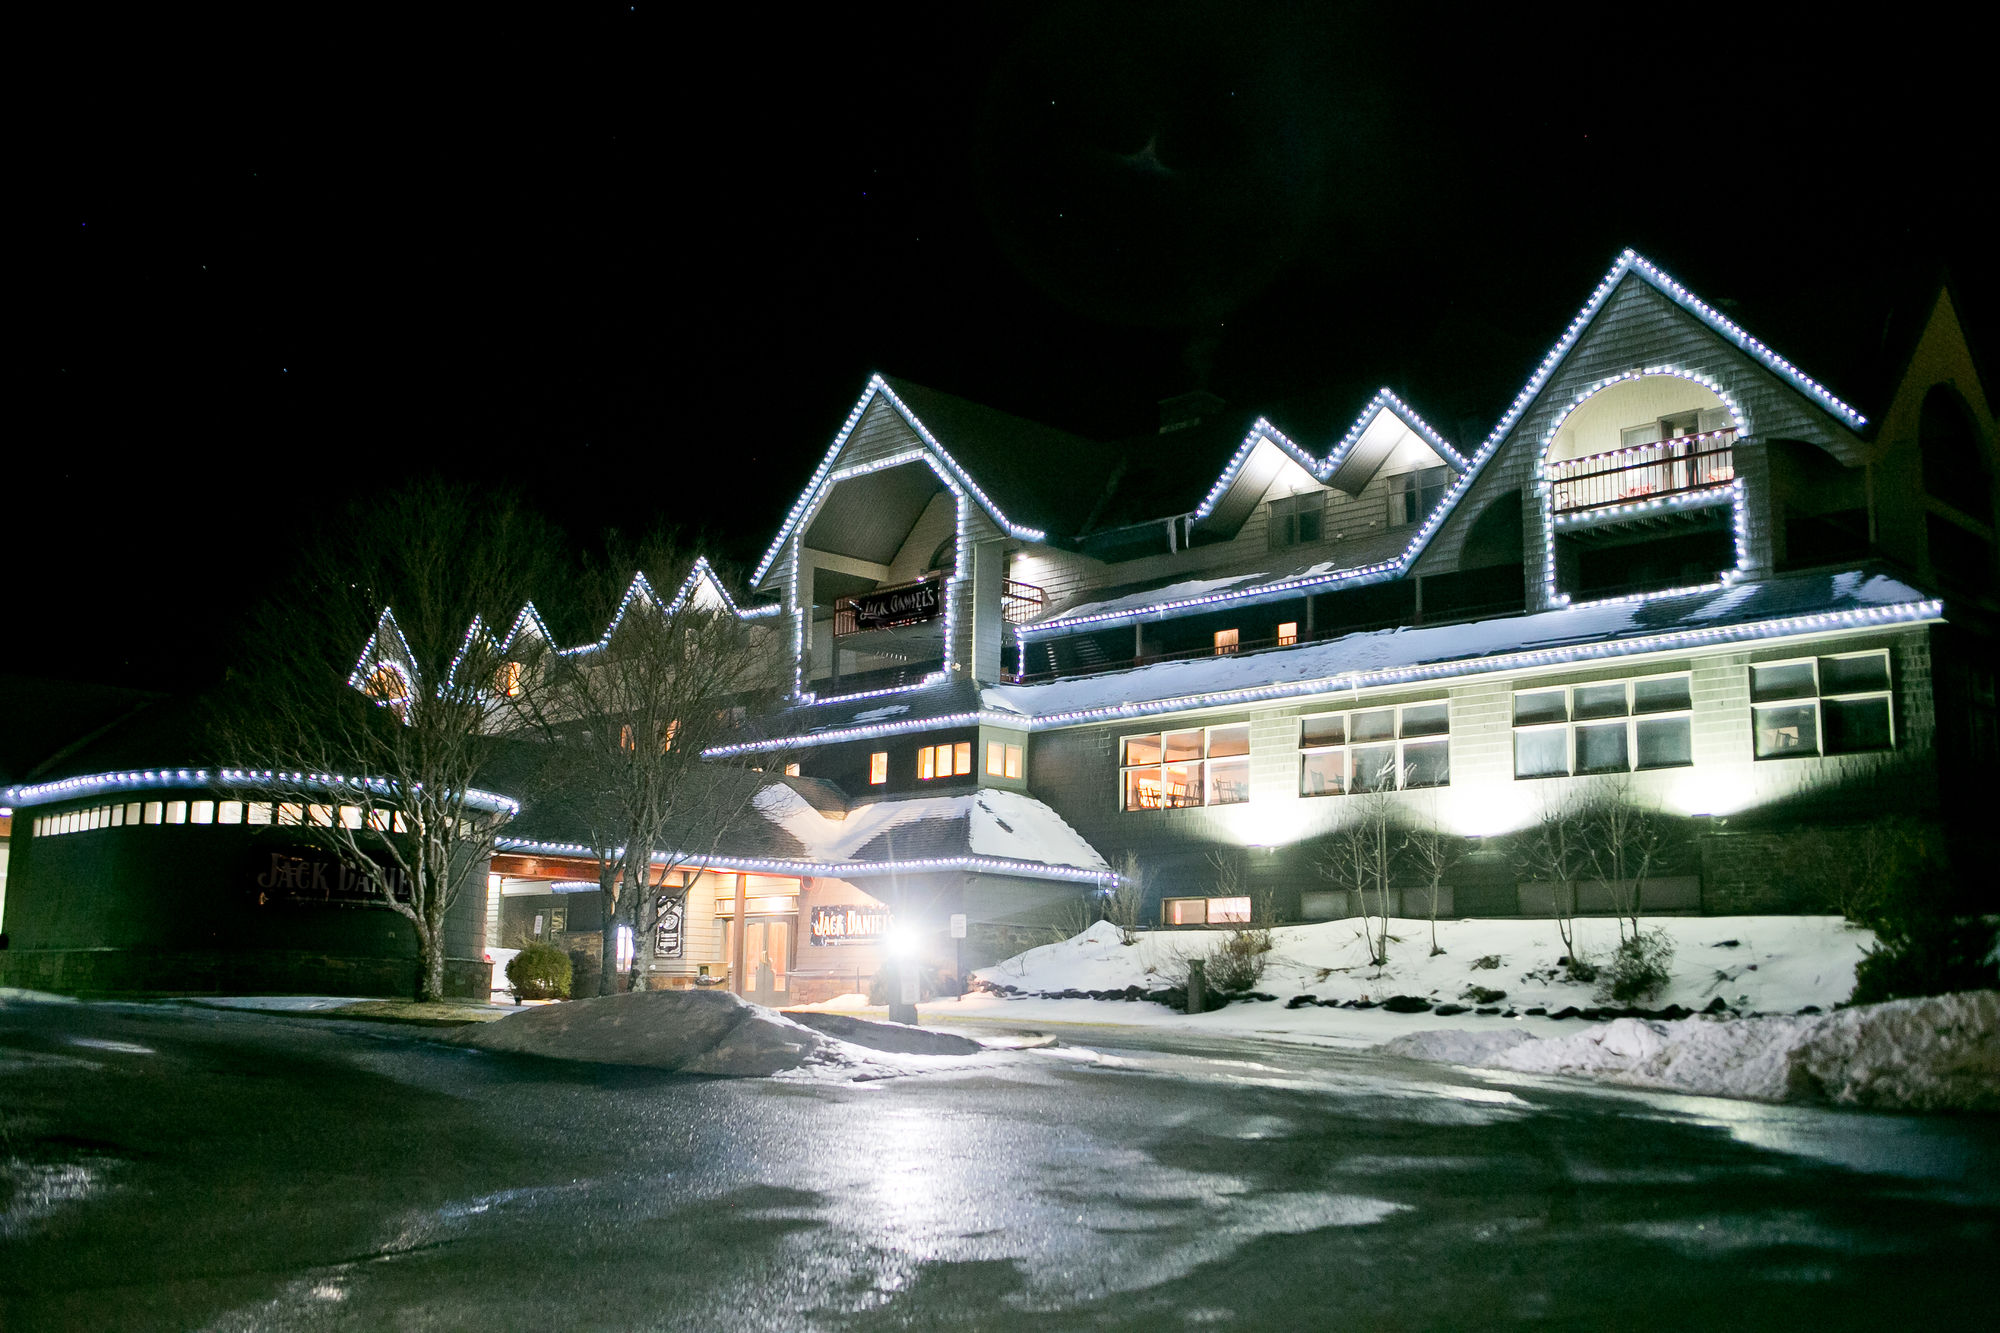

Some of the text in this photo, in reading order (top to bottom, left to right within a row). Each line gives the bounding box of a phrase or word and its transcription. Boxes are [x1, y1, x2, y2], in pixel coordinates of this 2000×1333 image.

[890, 586, 935, 614] DANIEL'S
[256, 852, 329, 890] JACK
[813, 910, 845, 936] JACK
